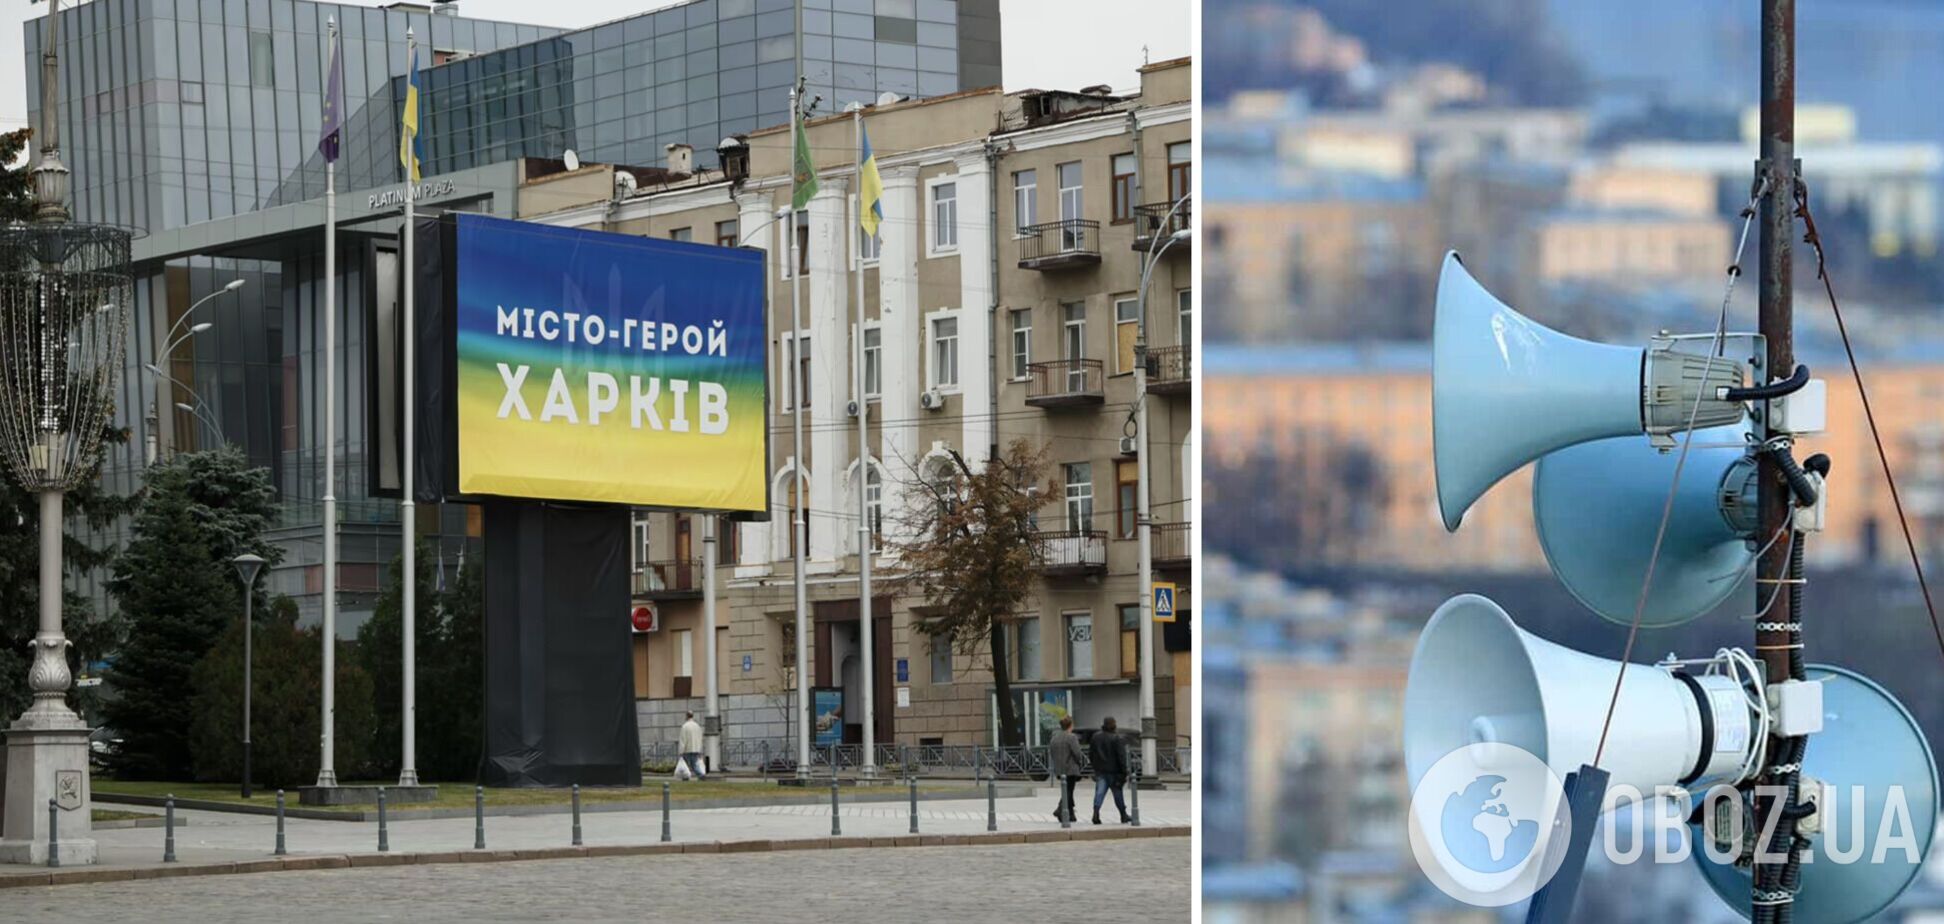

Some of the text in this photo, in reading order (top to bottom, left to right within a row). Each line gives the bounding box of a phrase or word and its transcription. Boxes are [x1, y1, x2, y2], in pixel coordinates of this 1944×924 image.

[425, 180, 455, 197] PLAZA
[497, 305, 727, 357] МІСТО-ГЕРОЙ
[496, 362, 729, 435] ХАРКІВ
